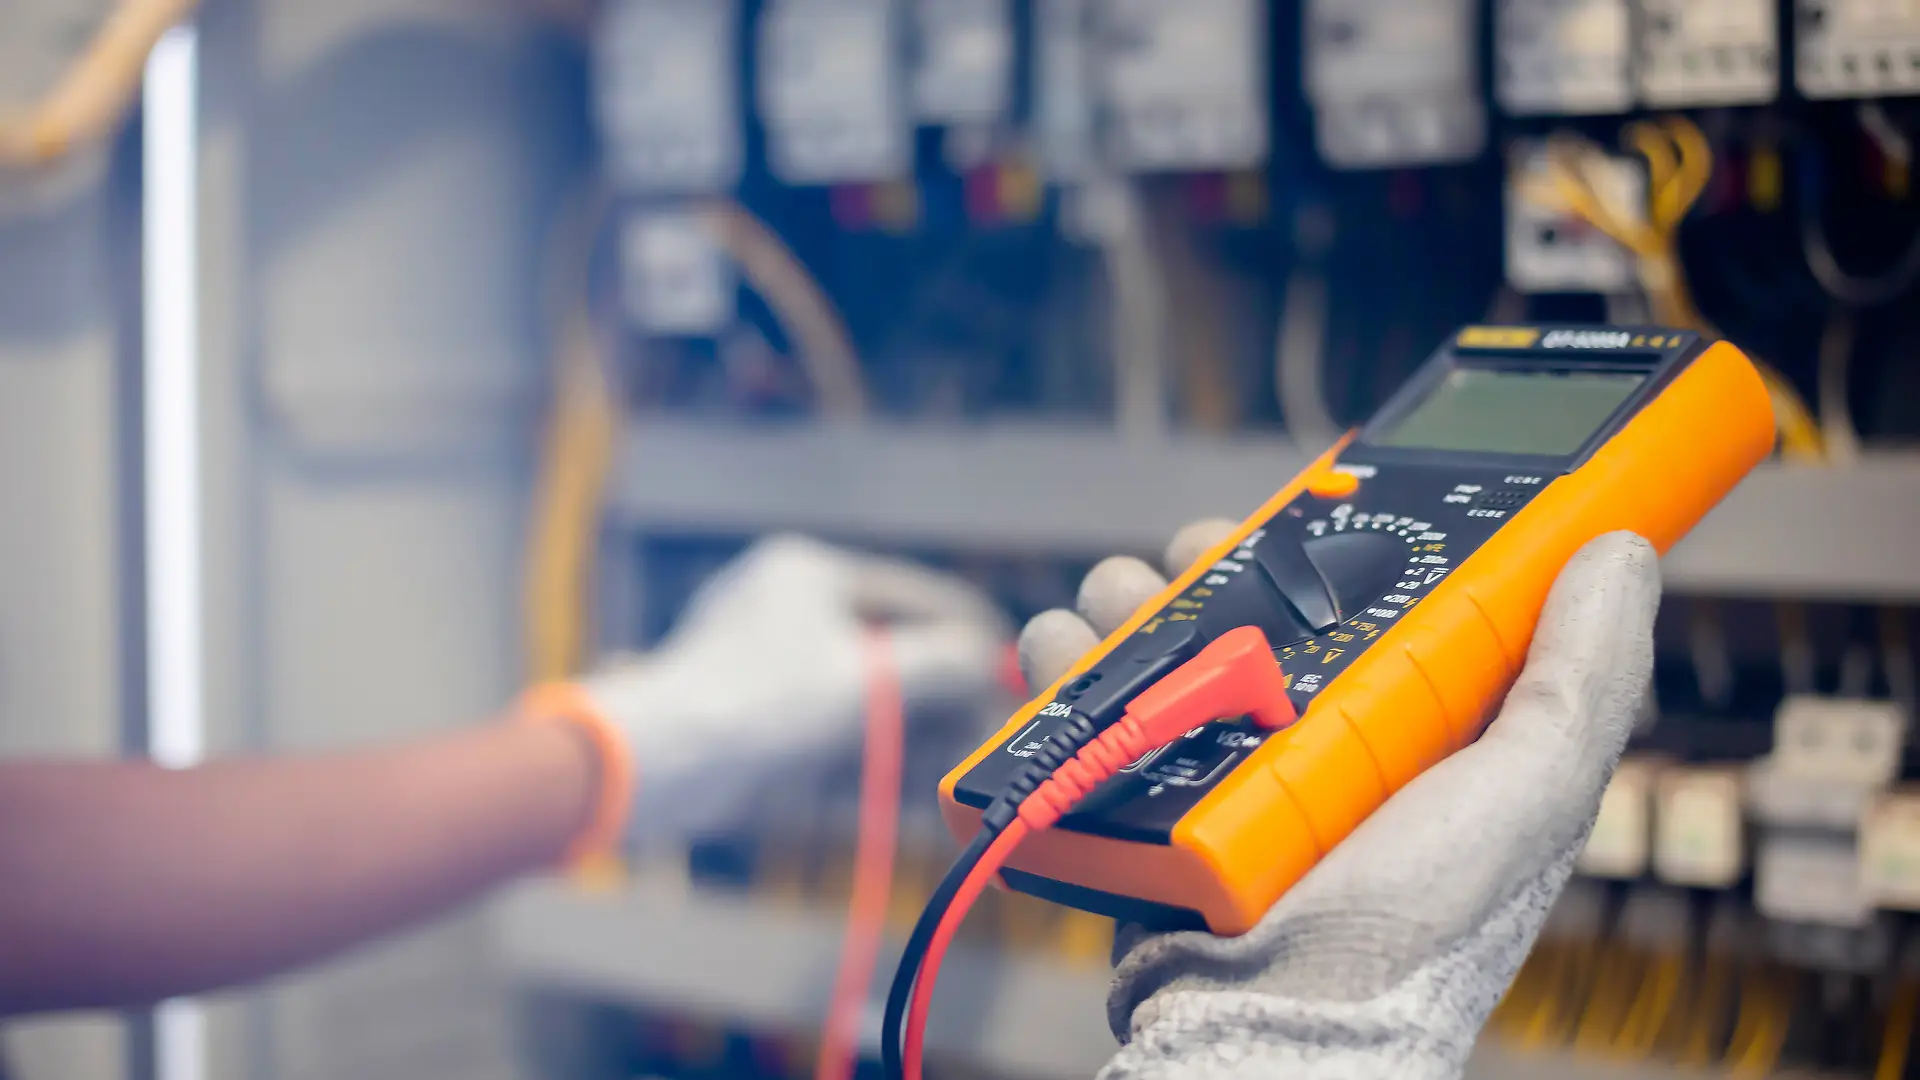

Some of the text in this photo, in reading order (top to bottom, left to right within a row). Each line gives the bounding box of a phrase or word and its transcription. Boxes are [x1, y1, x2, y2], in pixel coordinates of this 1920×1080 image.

[1467, 509, 1505, 517] ECBE
[1413, 567, 1425, 575] 2
[1403, 581, 1420, 589] 20
[1388, 594, 1411, 603] 200
[1372, 609, 1399, 618] 1000
[1355, 621, 1377, 632] 750
[1333, 633, 1355, 642] 200
[1303, 645, 1321, 654] 20
[1283, 651, 1296, 660] 2
[1300, 674, 1323, 683] IEC
[1292, 682, 1319, 693] 1010
[1039, 701, 1074, 718] 20A
